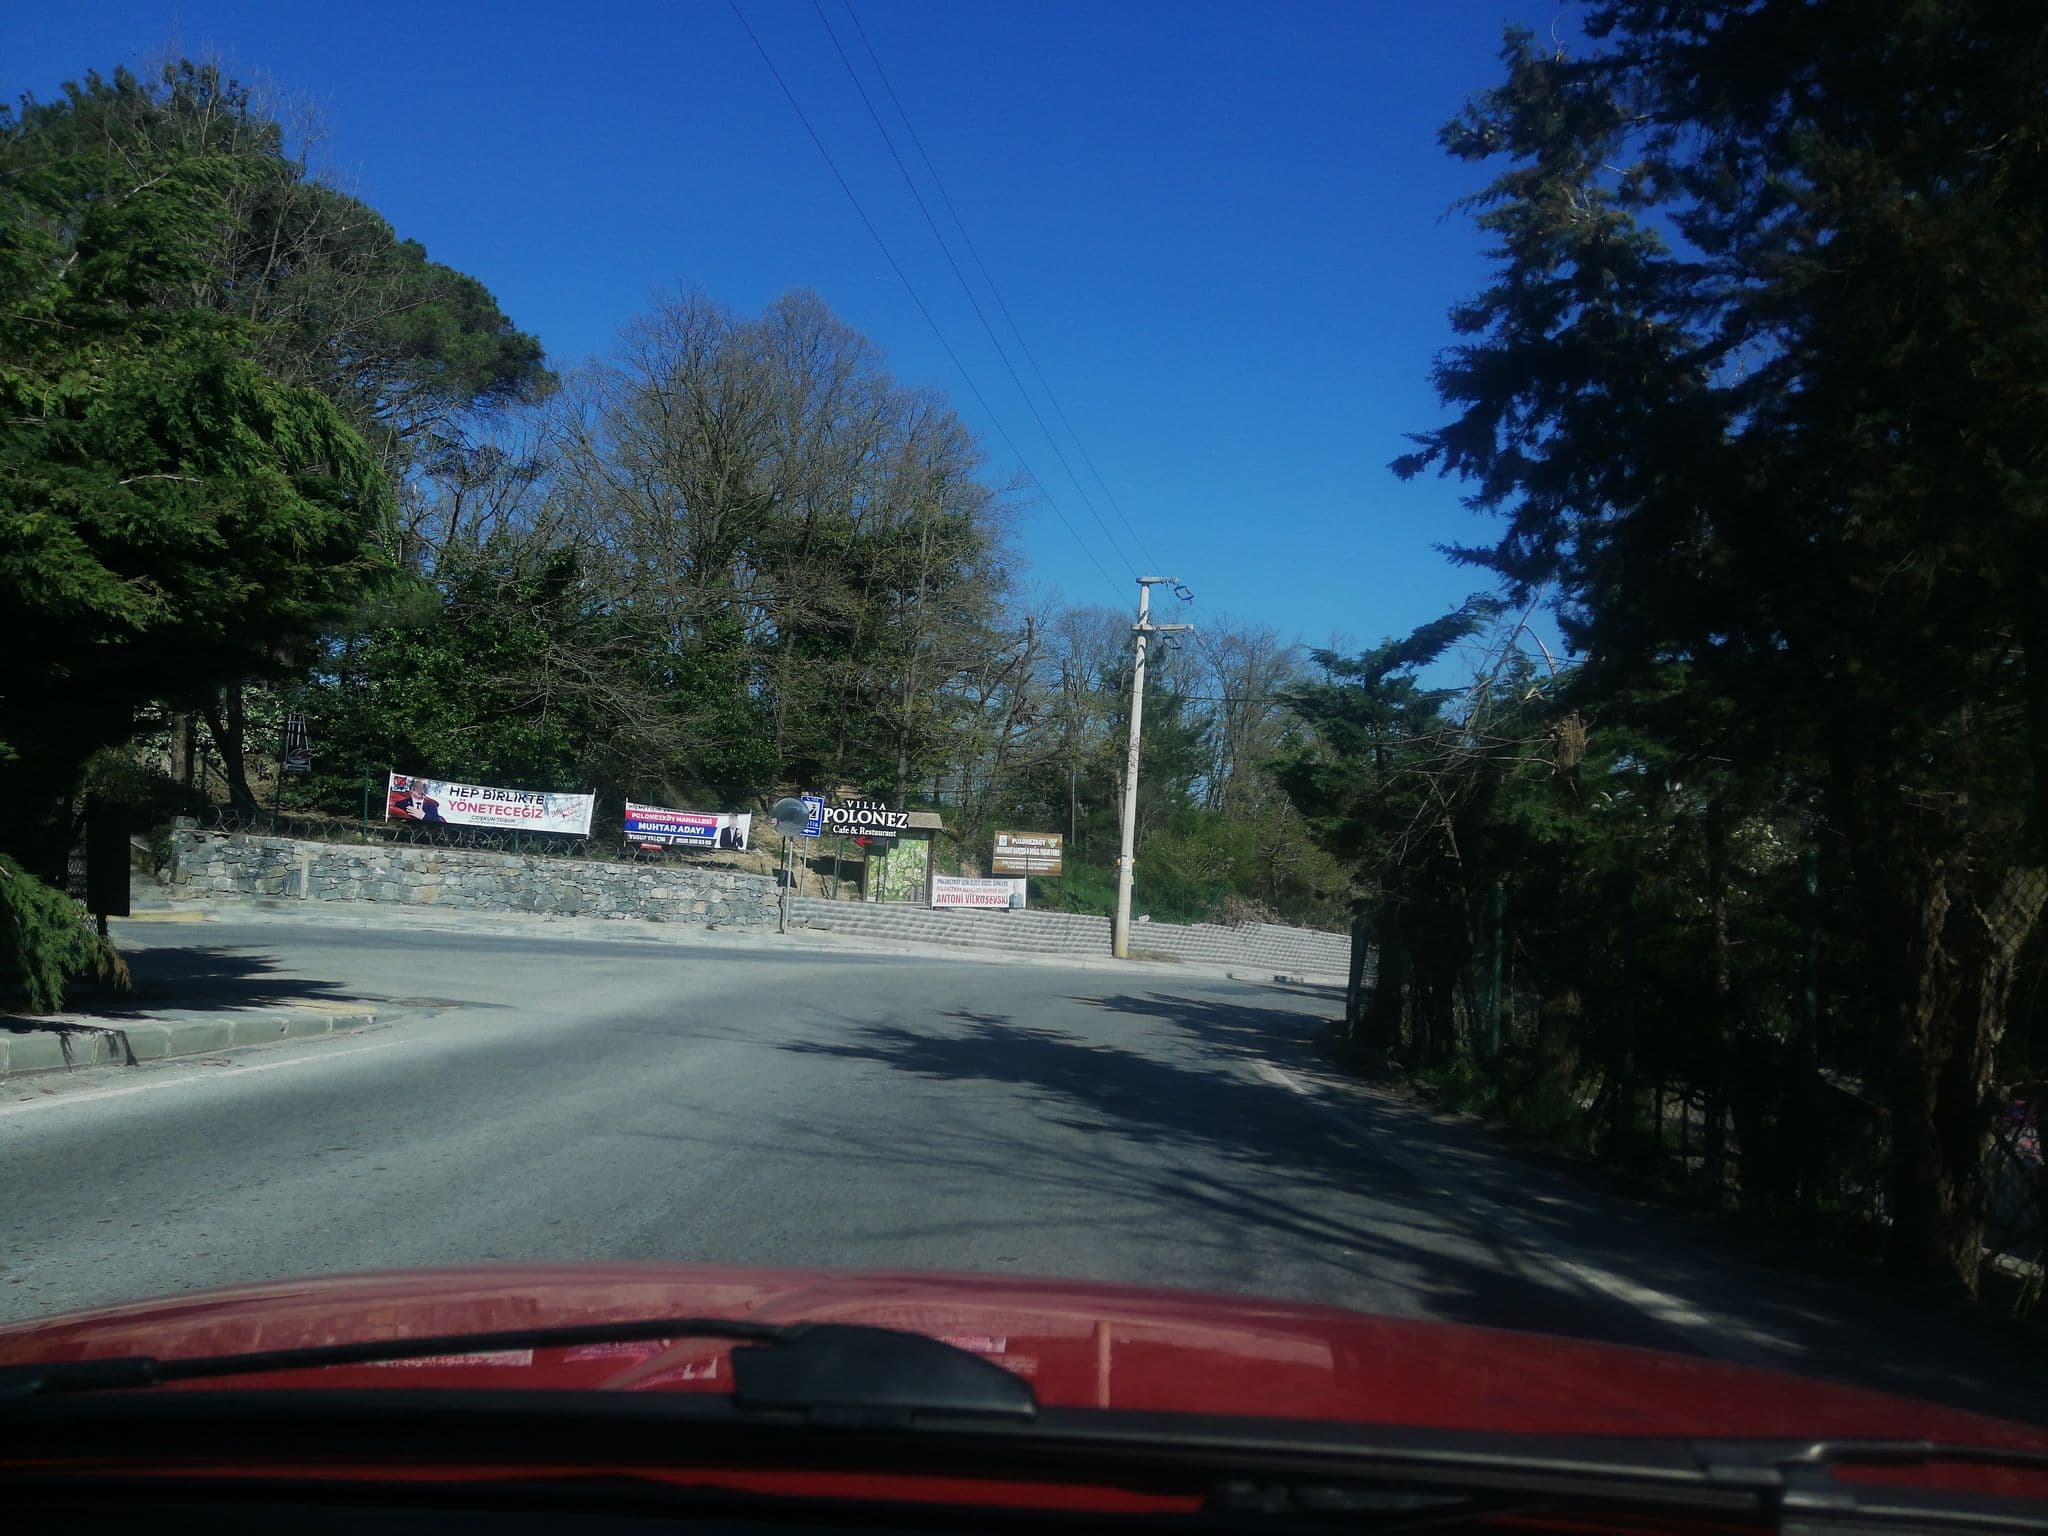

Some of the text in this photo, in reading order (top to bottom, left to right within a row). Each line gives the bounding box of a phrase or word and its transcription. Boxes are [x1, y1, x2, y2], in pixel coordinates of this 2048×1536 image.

[449, 786, 545, 805] HEP BİRLİKTE
[448, 799, 544, 819] YÖNETECEĞİZ
[847, 800, 887, 811] VILLA
[823, 808, 908, 829] POLONEZ
[638, 822, 705, 835] MUHTAR ADAYI
[833, 825, 897, 837] Cafe & Restaurant
